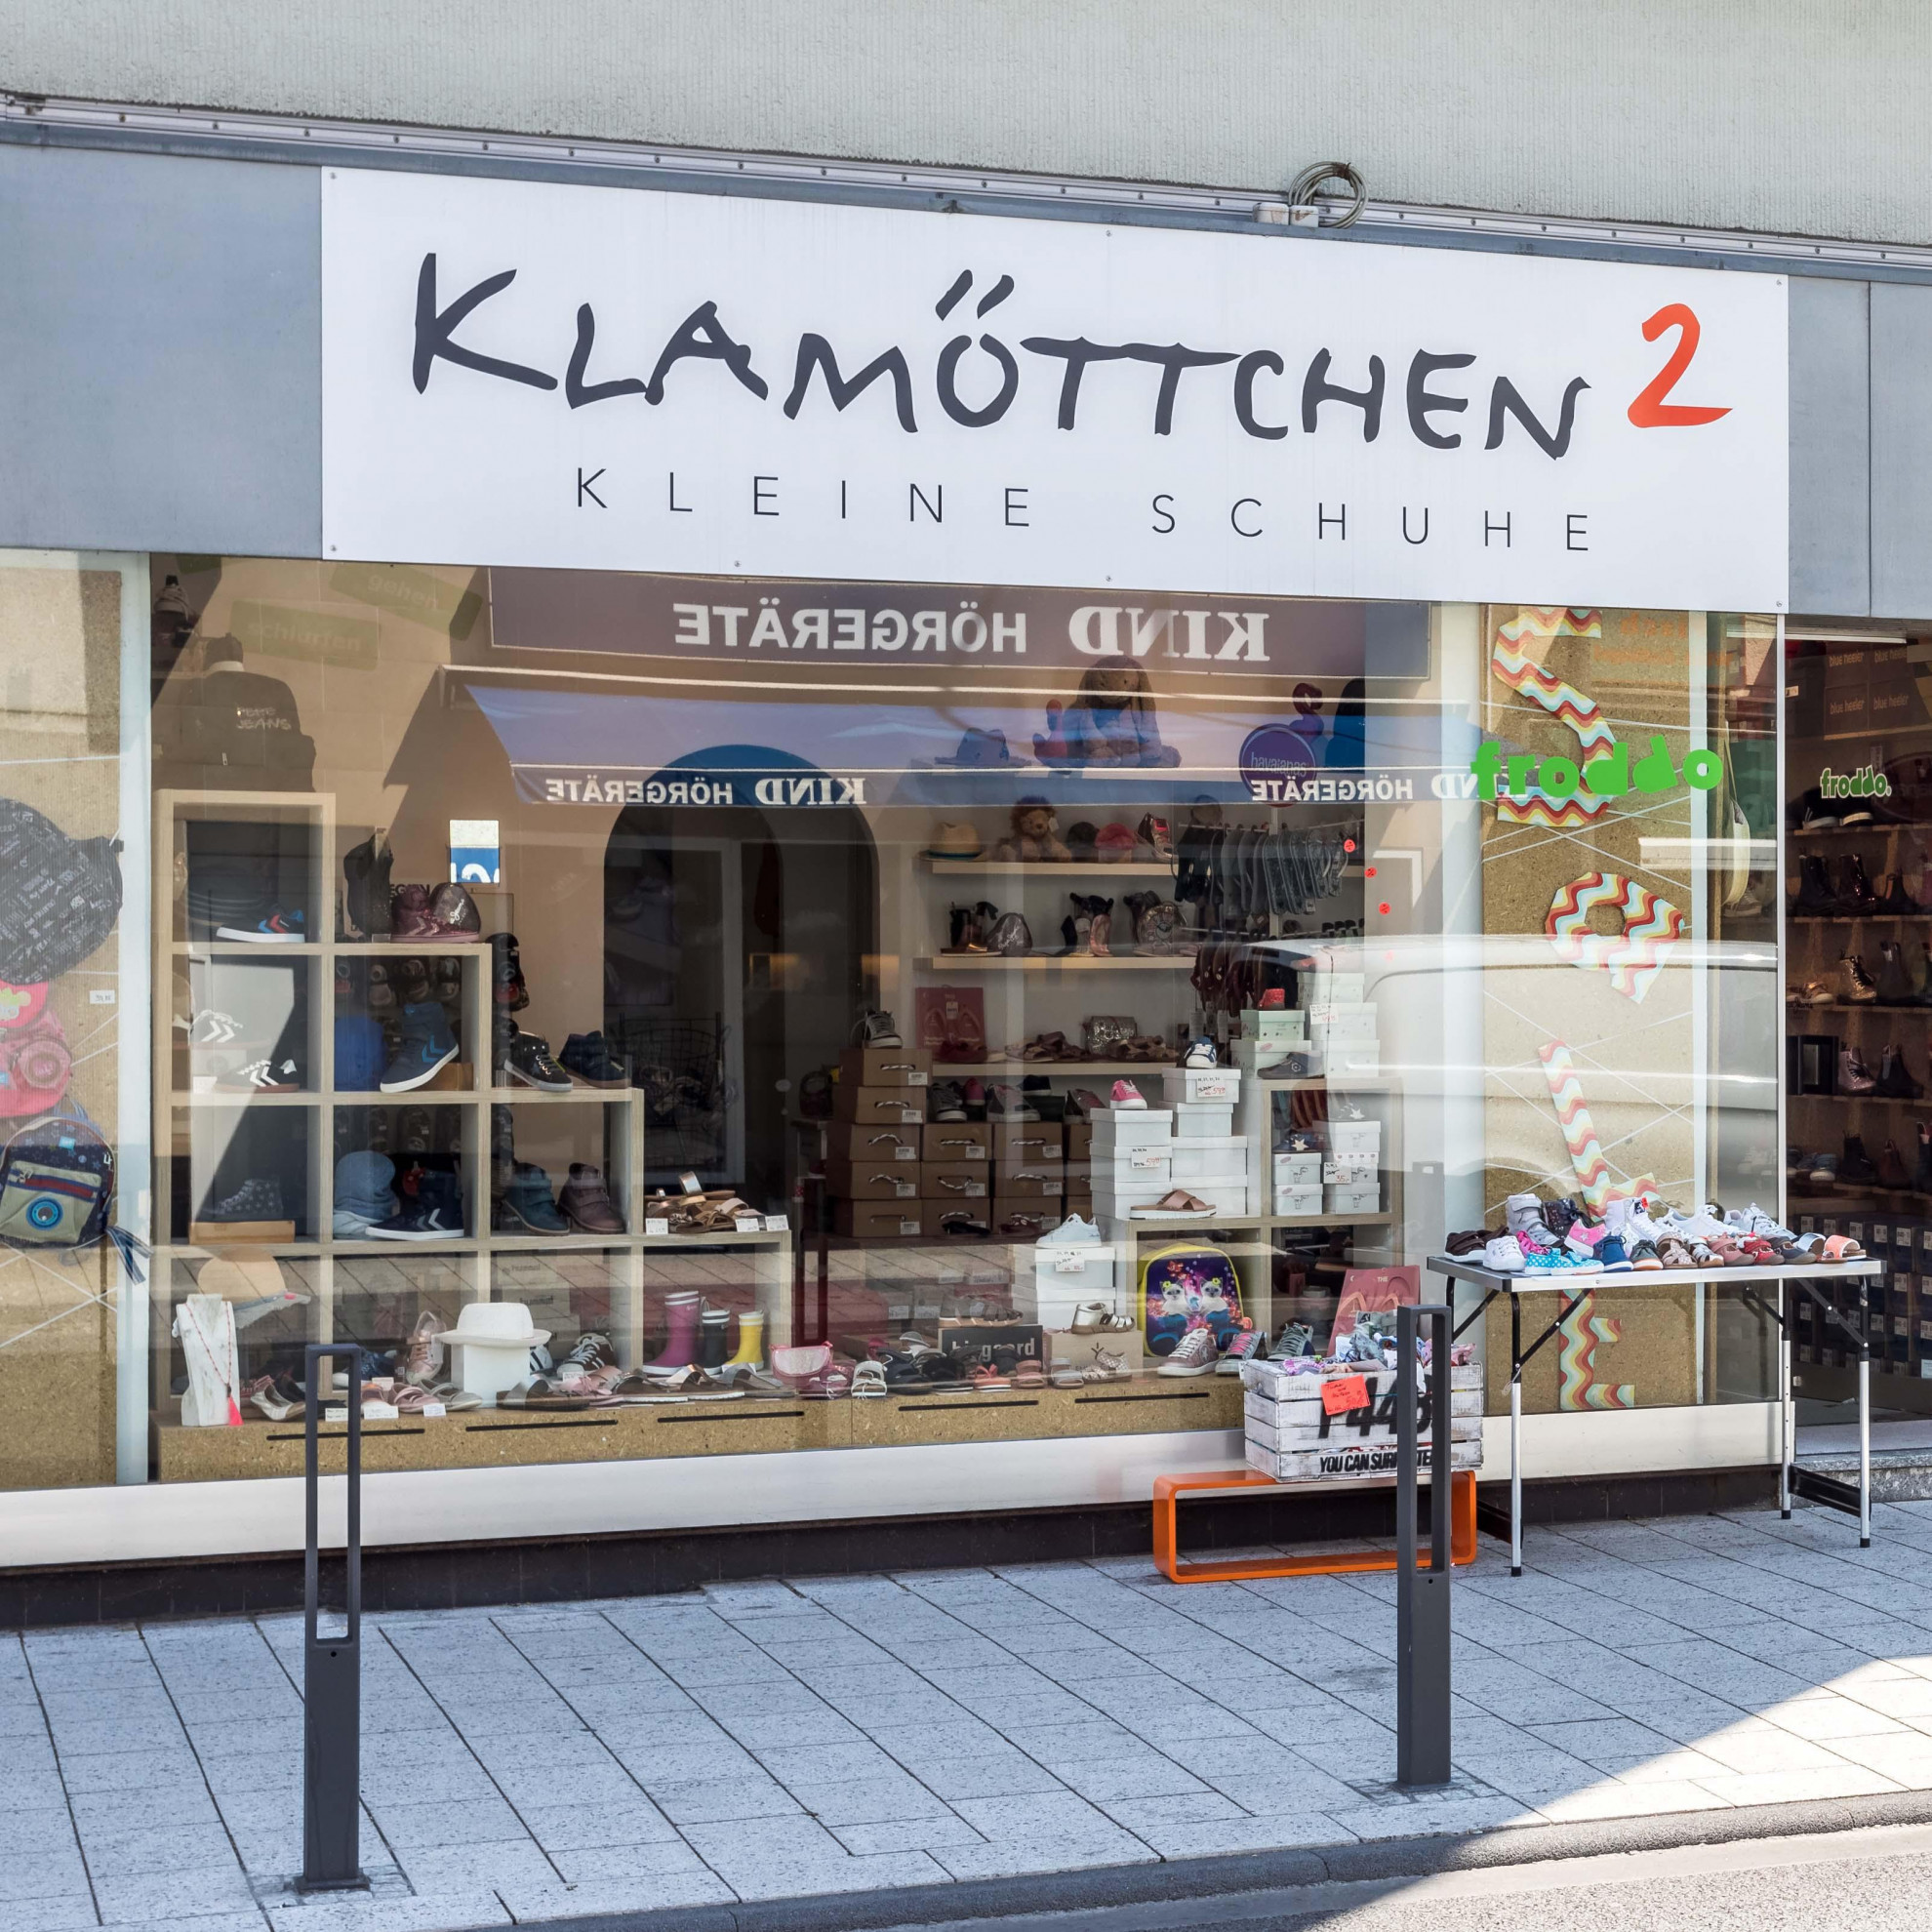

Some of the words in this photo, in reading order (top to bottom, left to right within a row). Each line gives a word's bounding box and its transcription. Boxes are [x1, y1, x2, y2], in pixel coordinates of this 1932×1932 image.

[413, 253, 1591, 460] KLAMÖTTCHEN
[1628, 303, 1731, 427] 2
[578, 468, 1029, 526] KLEINE
[1151, 495, 1589, 550] SCHUHE
[1470, 734, 1724, 800] froddo
[1320, 1455, 1344, 1472] YOU
[1345, 1454, 1370, 1471] CAN
[1370, 1451, 1398, 1470] SUR
